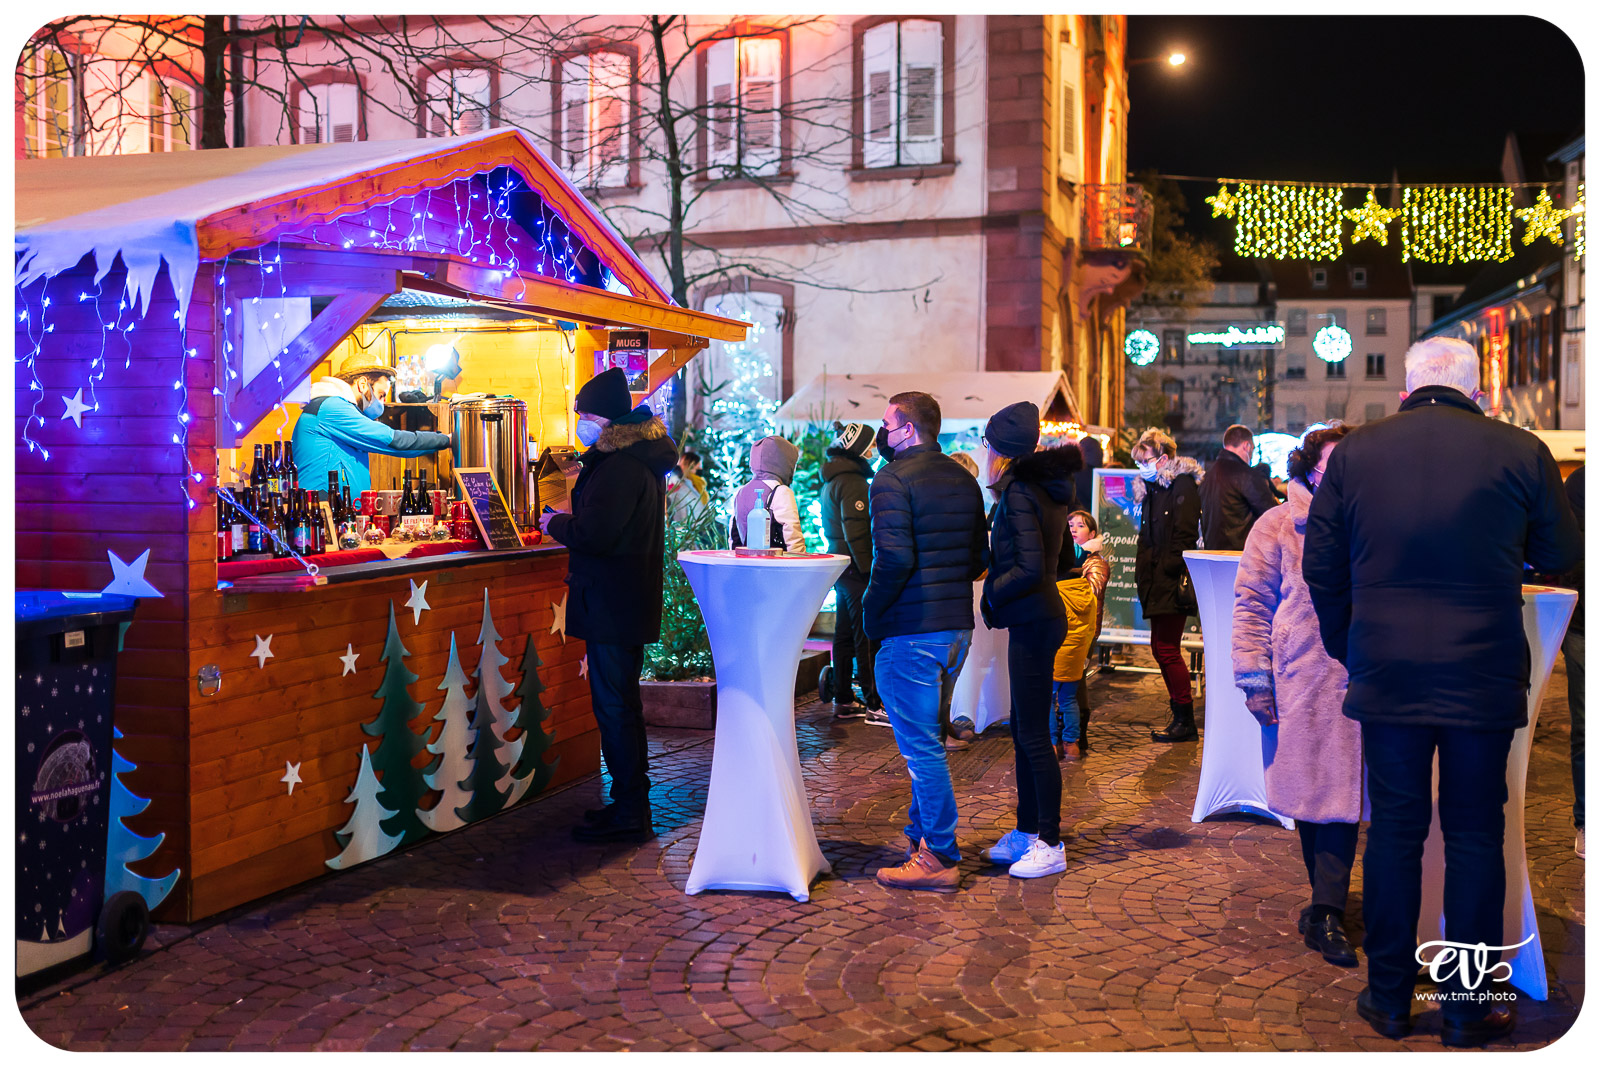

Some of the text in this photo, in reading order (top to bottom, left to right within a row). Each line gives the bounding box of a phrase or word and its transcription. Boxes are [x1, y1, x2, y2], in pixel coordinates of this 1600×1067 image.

[616, 339, 641, 347] MUGS
[1108, 554, 1119, 563] Du
[31, 779, 101, 804] www.noelahaguenau.fr
